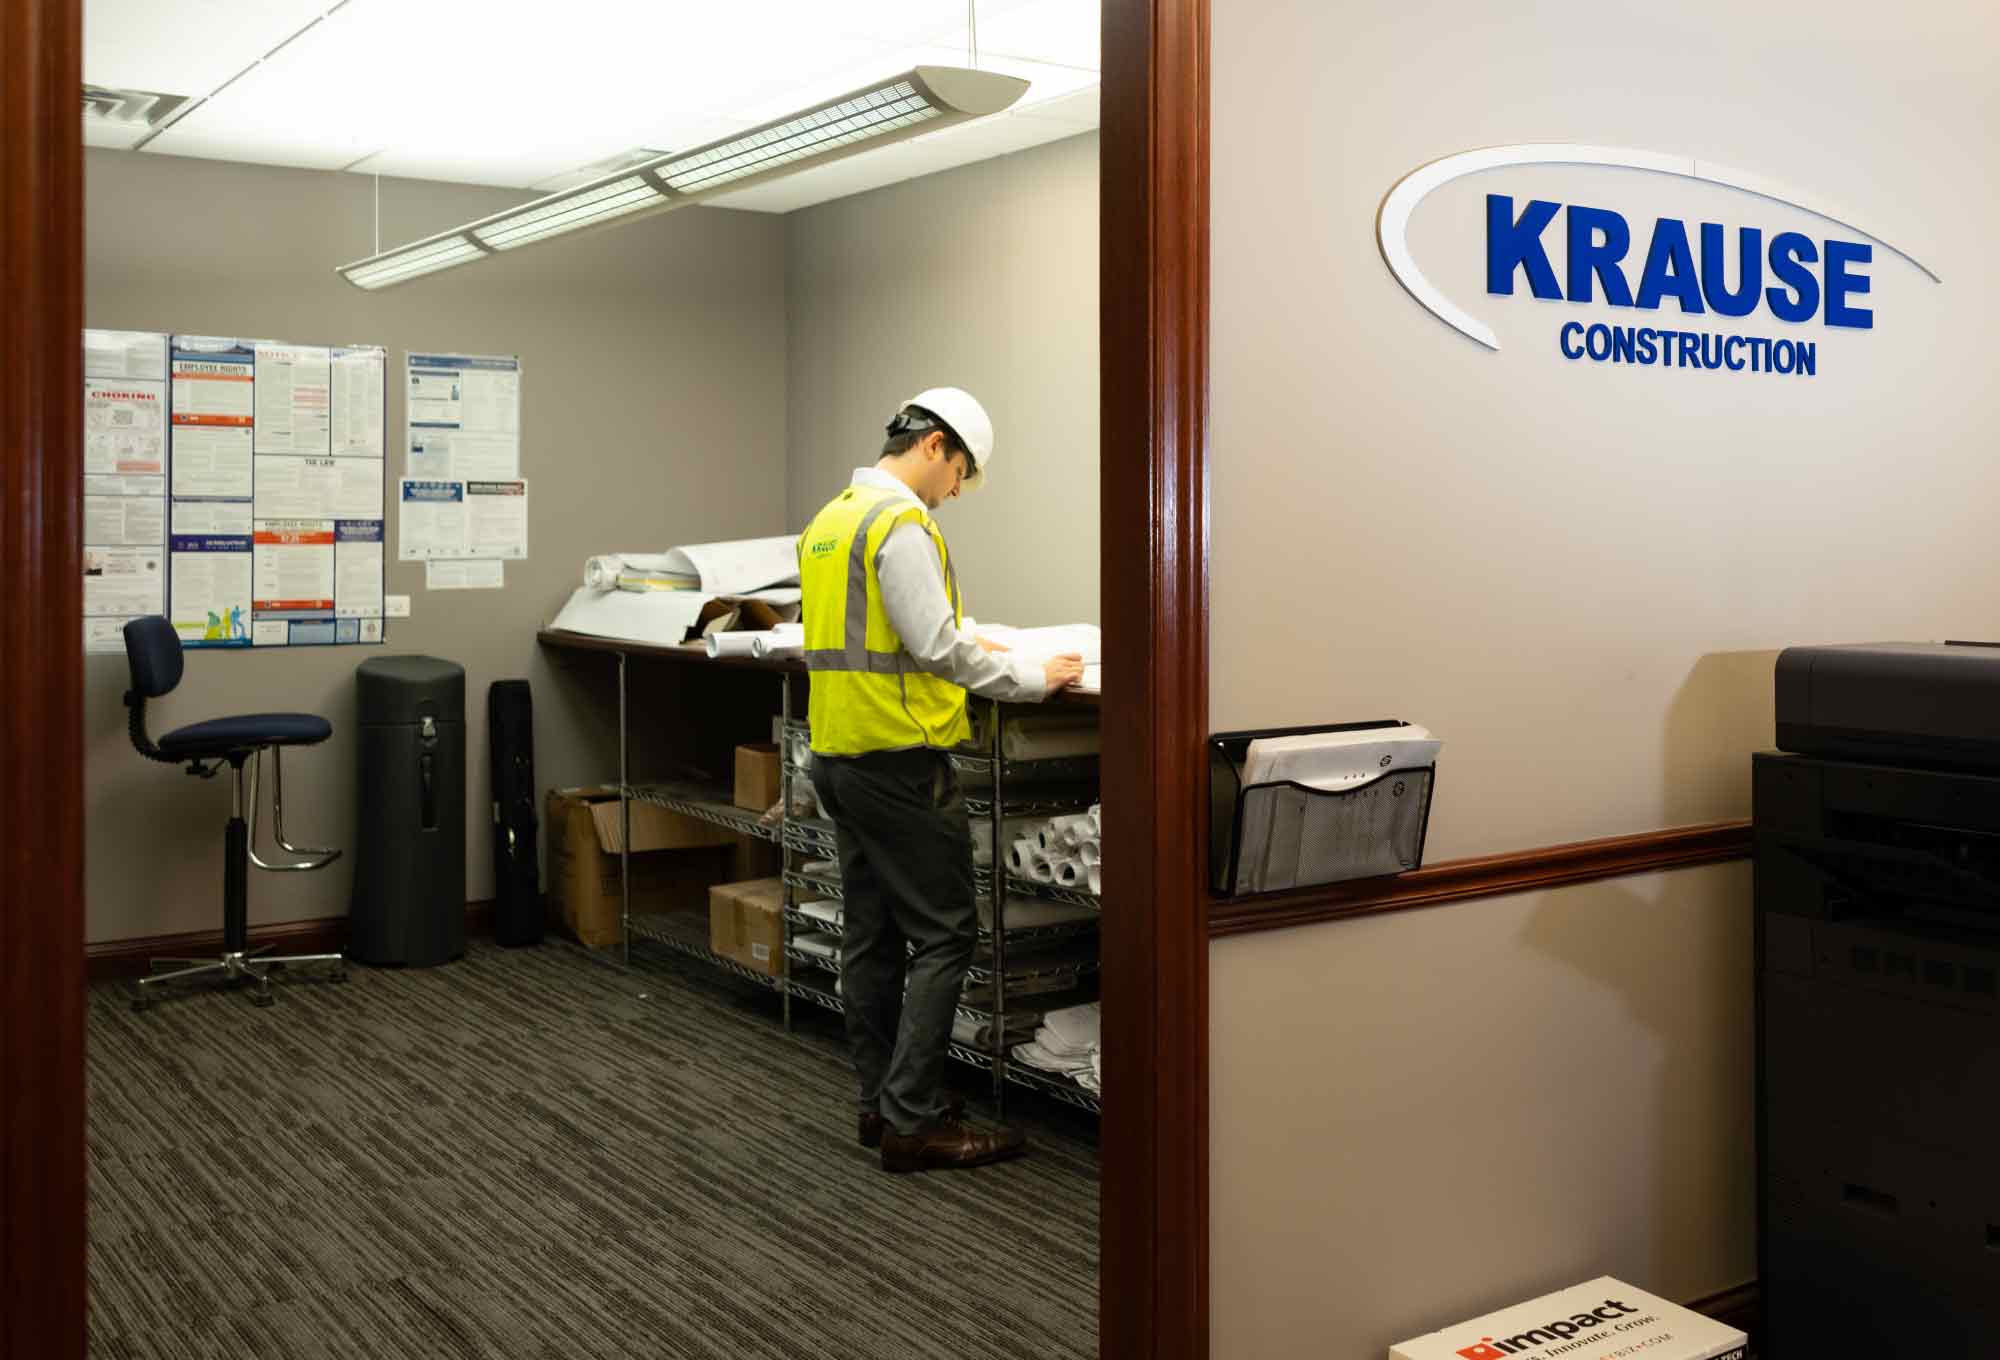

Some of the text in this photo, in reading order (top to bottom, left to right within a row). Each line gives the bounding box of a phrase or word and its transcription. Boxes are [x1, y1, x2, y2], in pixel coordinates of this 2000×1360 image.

[1486, 193, 1874, 330] KRAUSE
[1560, 321, 1816, 376] CONSTRUCTION
[1481, 1299, 1639, 1354] impact
[1614, 1313, 1660, 1333] Grow.
